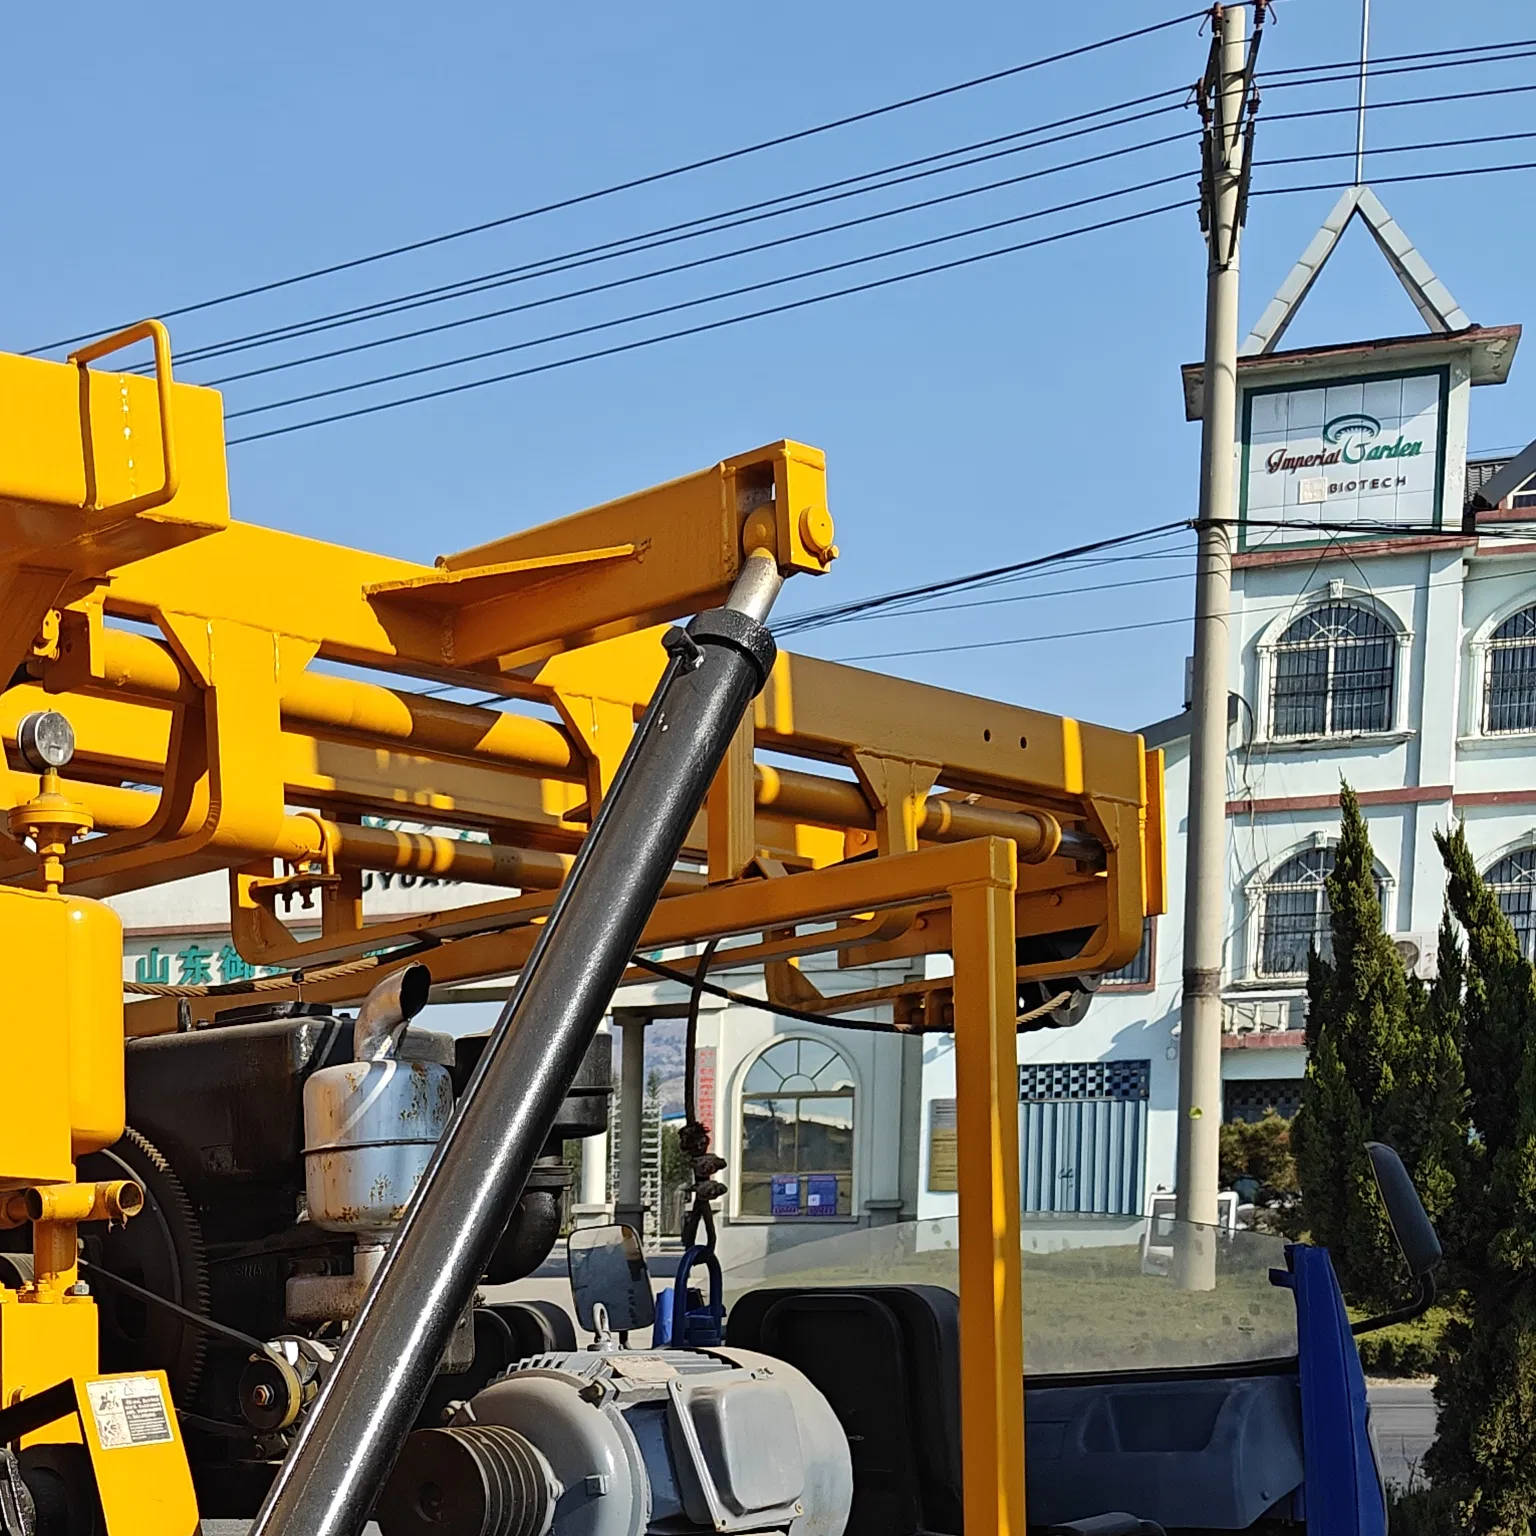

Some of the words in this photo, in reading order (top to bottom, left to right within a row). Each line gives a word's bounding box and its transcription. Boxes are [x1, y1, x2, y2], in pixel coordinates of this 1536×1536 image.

[1266, 448, 1342, 475] Imperial
[1340, 433, 1423, 465] Garden
[1328, 475, 1407, 495] BIOTECH
[136, 944, 288, 986] 山东御
